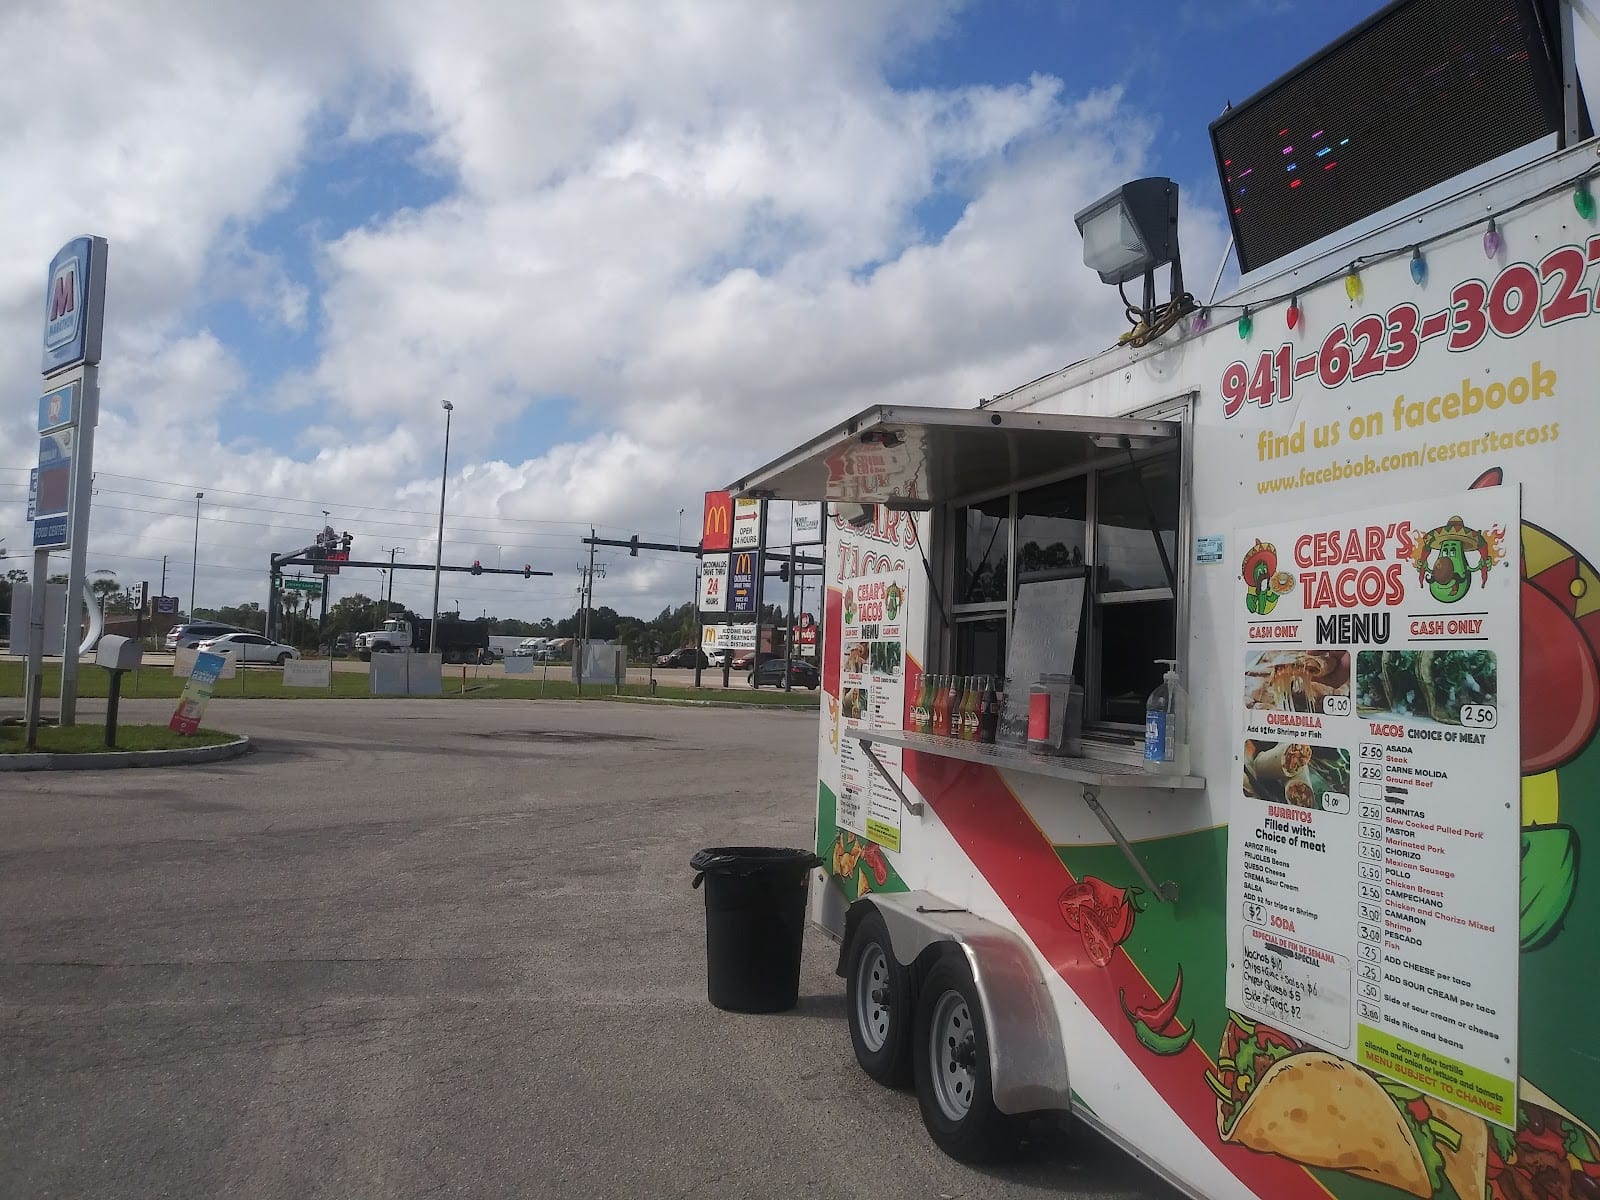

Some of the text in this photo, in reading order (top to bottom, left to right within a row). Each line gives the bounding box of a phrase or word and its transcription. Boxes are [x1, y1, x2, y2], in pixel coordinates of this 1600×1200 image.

[1220, 232, 1600, 419] 941-623-302
[1257, 361, 1557, 462] find us on facebook
[1257, 421, 1560, 494] www.facebook.com/cesarstacoss
[739, 527, 753, 536] OPEN
[741, 535, 757, 544] HOURS
[1294, 521, 1414, 569] CESAR'S
[707, 577, 719, 595] 24
[1300, 563, 1405, 610] TACOS
[735, 602, 747, 611] FAST
[859, 602, 883, 622] TACOS
[861, 624, 880, 640] MENU
[1249, 625, 1299, 639] CASH ONLY
[1316, 612, 1391, 645] MENU
[1410, 619, 1483, 636] CASH ONLY
[1327, 698, 1348, 711] 9.00
[1266, 713, 1322, 728] QUESADILLA
[1464, 706, 1493, 722] 2.50
[1247, 725, 1259, 733] Add
[1277, 728, 1299, 738] Shrimp
[1370, 723, 1486, 745] TACOS CHOICE OF MEAT
[1361, 746, 1382, 758] 2.50
[1385, 745, 1413, 754] ASADA
[1385, 755, 1408, 764] Steak
[1385, 765, 1448, 779] CARNE MOLIDA
[1385, 776, 1433, 788] Ground Beef
[1268, 805, 1313, 823] BURRITOS
[1385, 806, 1425, 819] CARNITAS
[1264, 818, 1316, 838] Filled with:
[1362, 826, 1381, 839] 2.50
[1385, 816, 1484, 839] Slow Cooked Pulled Pork
[1385, 826, 1416, 838] PASTOR
[1244, 841, 1277, 854] ARROZ Rice
[1255, 829, 1326, 853] Choice of meat
[1385, 837, 1445, 855] Marinated Pork
[1362, 845, 1380, 859] 2.50
[1385, 847, 1421, 860] CHORIZO
[1244, 861, 1286, 878] QUESO Cheese
[1272, 858, 1290, 868] Beans
[1385, 857, 1455, 878] Mexican Sausage
[1361, 866, 1380, 879] 2.50
[1385, 867, 1411, 879] POLLO
[1243, 881, 1263, 893] SALSA
[1244, 871, 1299, 892] CREMA Sour Cream
[1385, 878, 1444, 897] Chicken Breast
[1243, 892, 1256, 901] ADD
[1265, 898, 1273, 906] for
[1296, 907, 1318, 920] Shrimp
[1384, 888, 1443, 908] CAMPECHANO
[1248, 903, 1262, 921] $2
[1384, 899, 1495, 933] Chicken and Chorizo Mixed
[1384, 909, 1426, 926] CAMARON
[1270, 915, 1296, 933] SODA
[1384, 919, 1412, 933] Shrimp
[1384, 929, 1423, 946] PESCADO
[1384, 940, 1400, 951] Fish
[1252, 929, 1336, 964] ESPECIAL DE FIN DE SEMANA
[1362, 946, 1377, 961] .25
[1294, 952, 1321, 968] SPECIAL
[1362, 965, 1377, 980] .25
[1384, 954, 1472, 988] ADD CHEESE per taco
[1363, 984, 1377, 997] .50
[1384, 973, 1496, 1016] ADD SOUR CREAM per taco
[1384, 994, 1401, 1005] Side
[1411, 1005, 1428, 1016] sour
[1430, 1012, 1456, 1025] cream
[1457, 1020, 1467, 1029] or
[1468, 1024, 1499, 1040] cheese
[1383, 1014, 1464, 1049] Side Rice and beans
[1396, 1043, 1412, 1055] Corn
[1422, 1052, 1438, 1065] flour
[1439, 1060, 1463, 1076] tortilla
[1365, 1041, 1389, 1056] cilantro
[1390, 1051, 1403, 1061] and
[1404, 1057, 1423, 1069] onion
[1433, 1067, 1458, 1084] lettuce
[1460, 1080, 1474, 1090] and
[1476, 1085, 1504, 1102] tomato
[1366, 1051, 1503, 1116] MENU SUBJECT TO CHANGE
